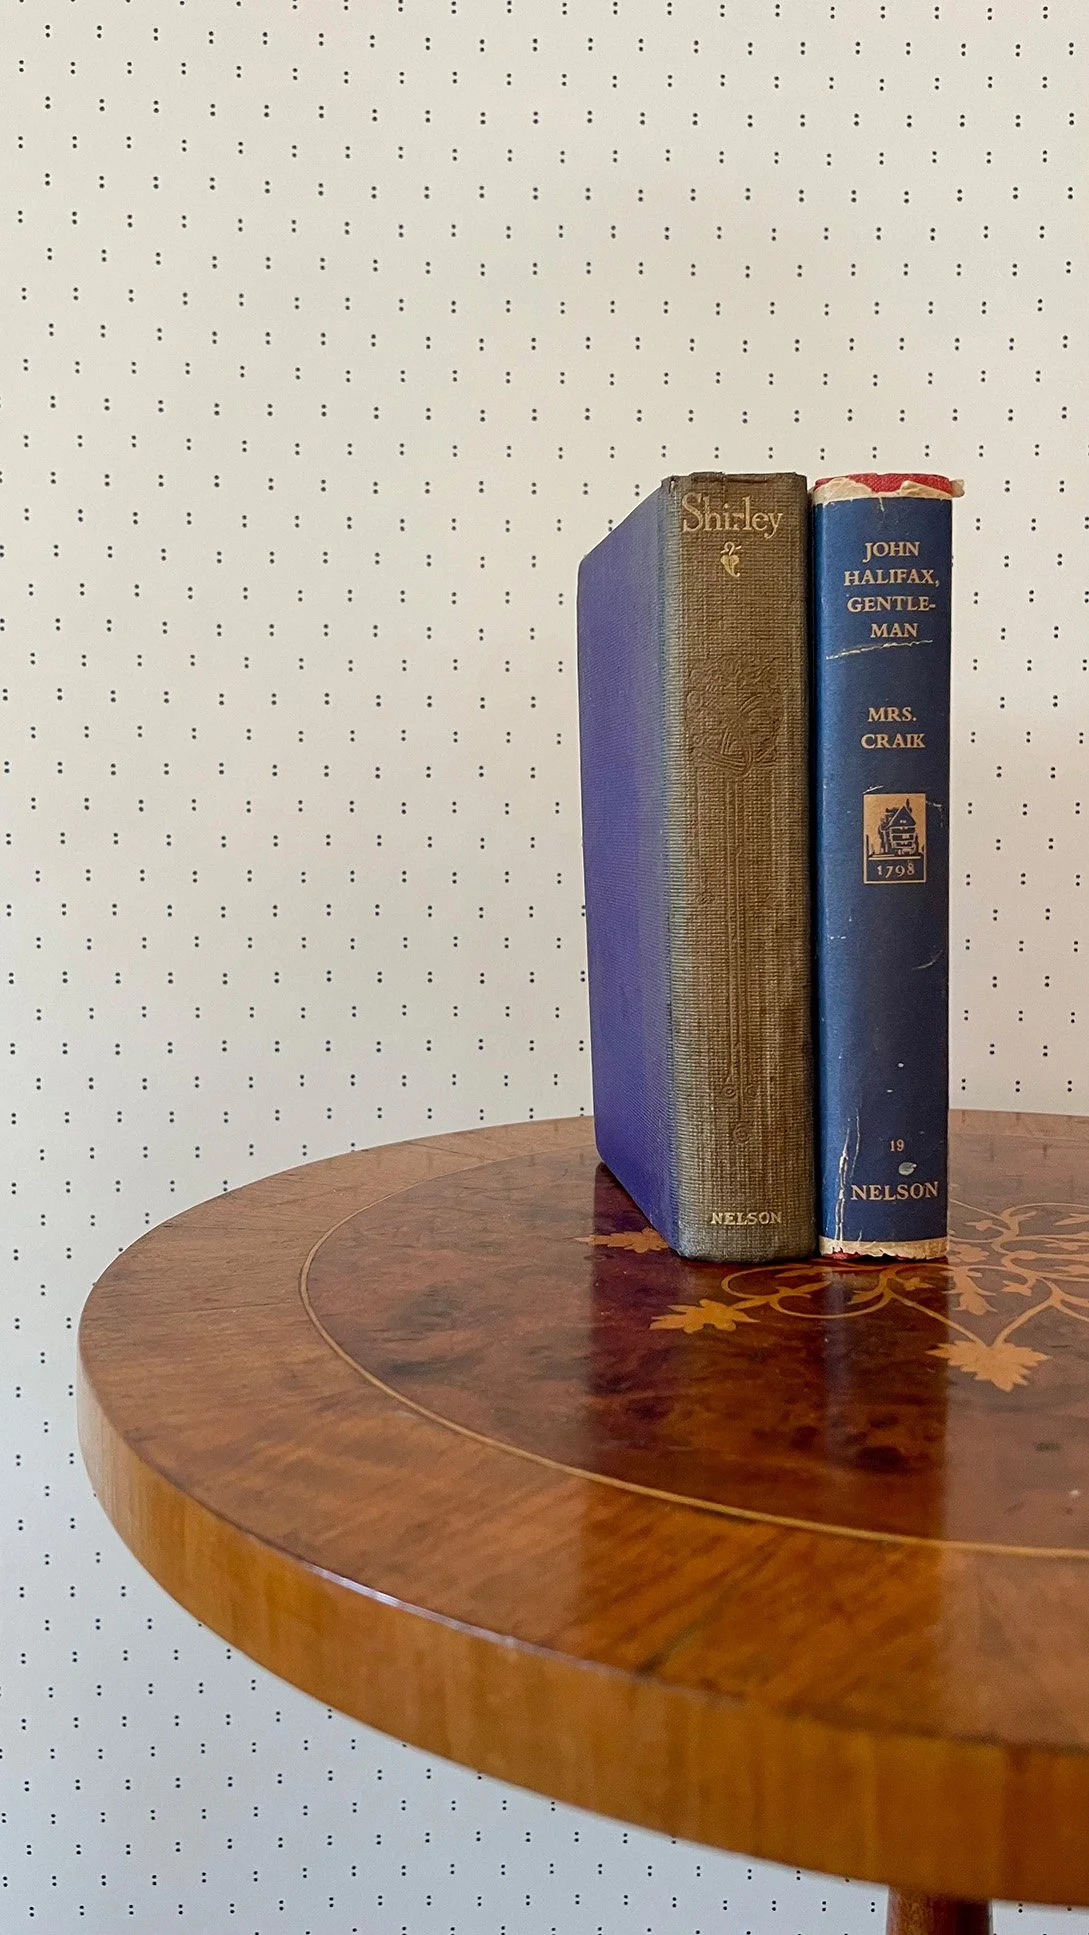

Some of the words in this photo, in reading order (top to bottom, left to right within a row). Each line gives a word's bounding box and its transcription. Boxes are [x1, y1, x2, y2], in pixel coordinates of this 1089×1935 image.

[682, 492, 783, 540] Shirley
[862, 541, 920, 563] JOHN
[844, 568, 939, 587] HALIFAX,
[847, 596, 936, 612] GENTLE-
[870, 623, 918, 638] MAN
[867, 706, 917, 722] MRS.
[861, 733, 926, 749] CRAIK
[877, 862, 915, 878] 1798
[890, 1138, 905, 1152] 19
[850, 1181, 939, 1201] NELSON
[710, 1212, 782, 1226] NELSON
